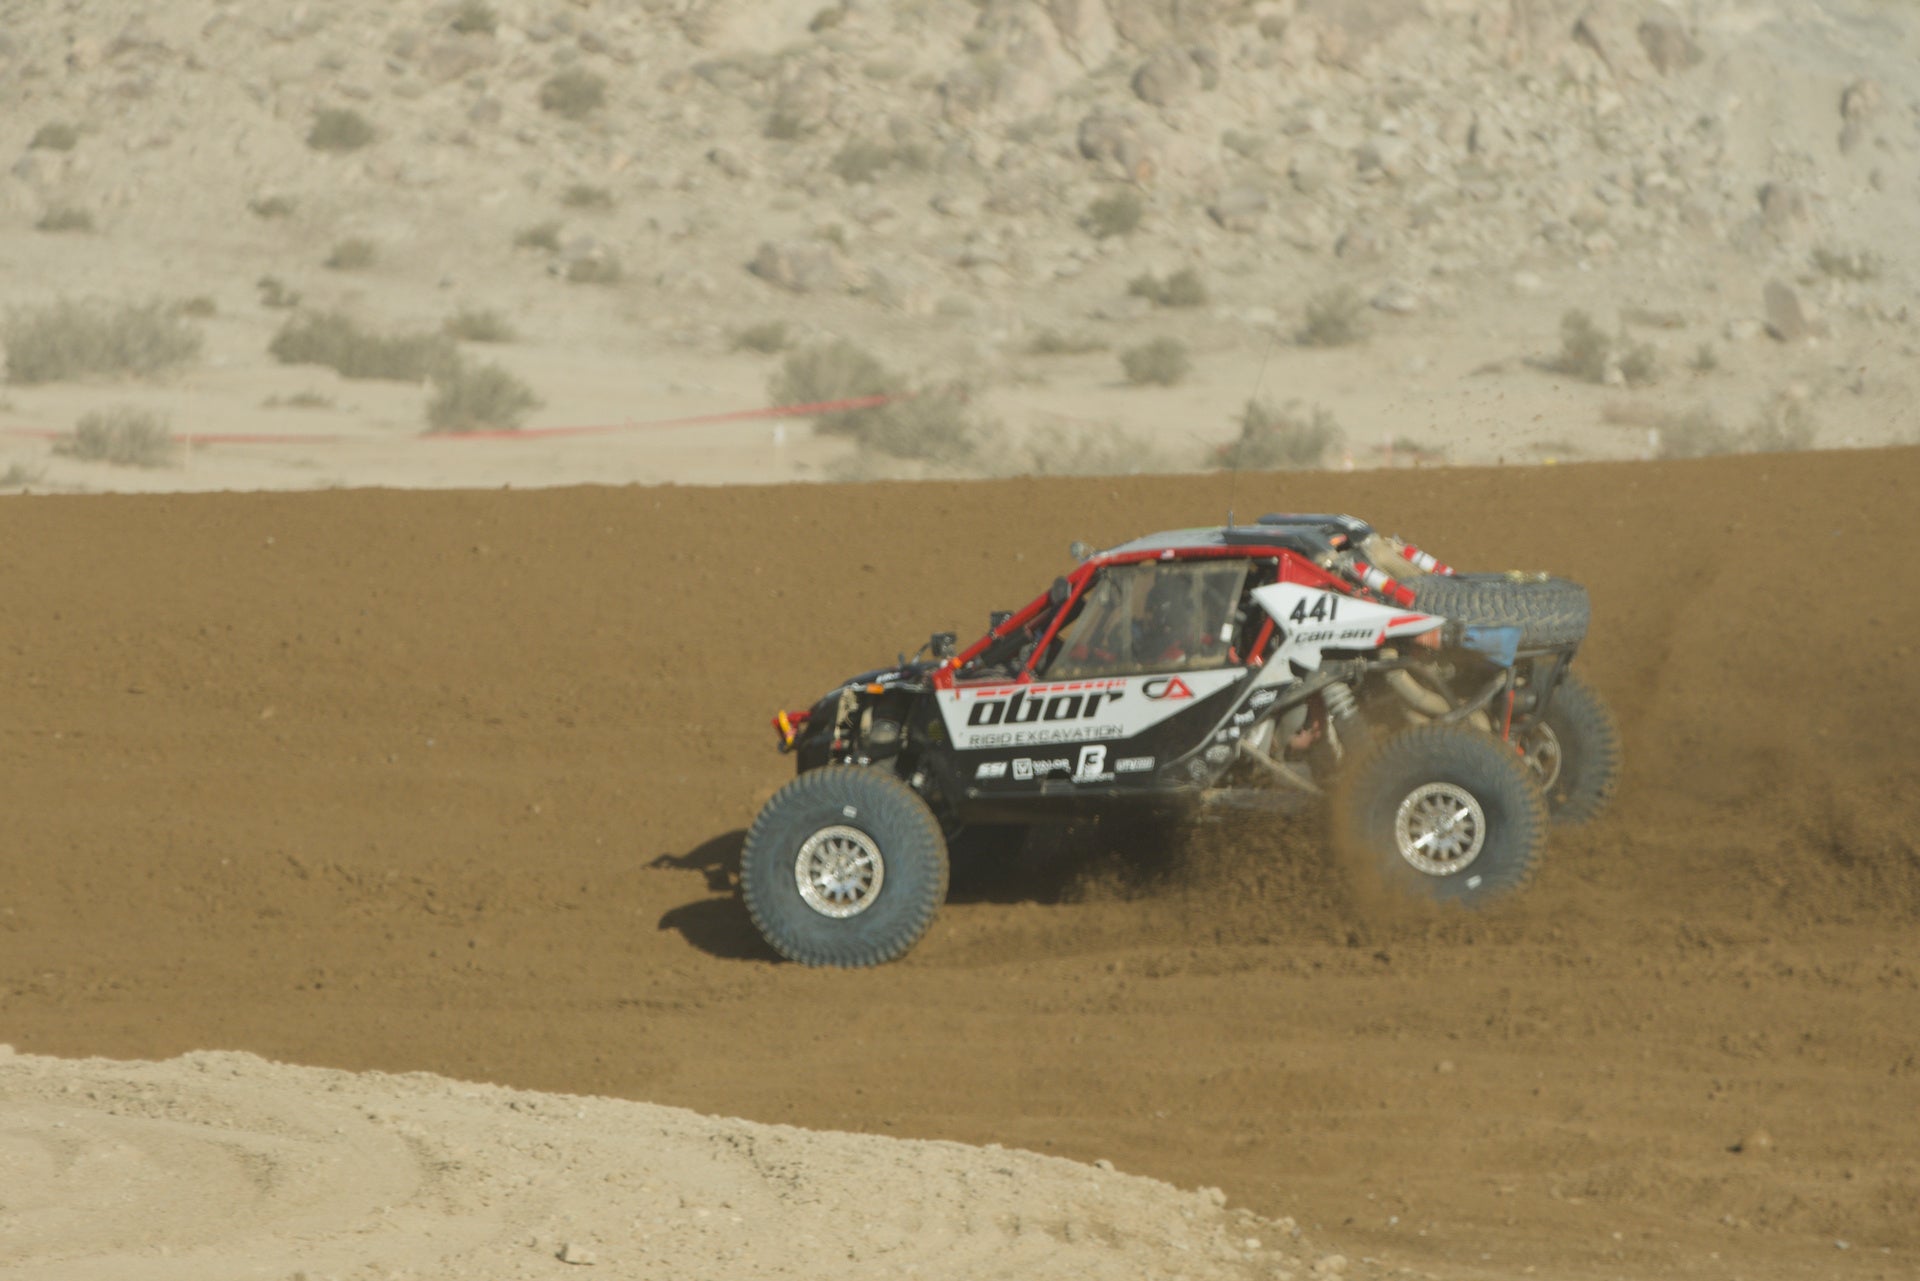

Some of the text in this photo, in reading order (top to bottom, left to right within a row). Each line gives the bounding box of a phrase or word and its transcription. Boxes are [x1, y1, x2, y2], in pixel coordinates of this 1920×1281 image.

[1290, 594, 1340, 625] 441
[969, 724, 1124, 746] RIGID EXCAVATION
